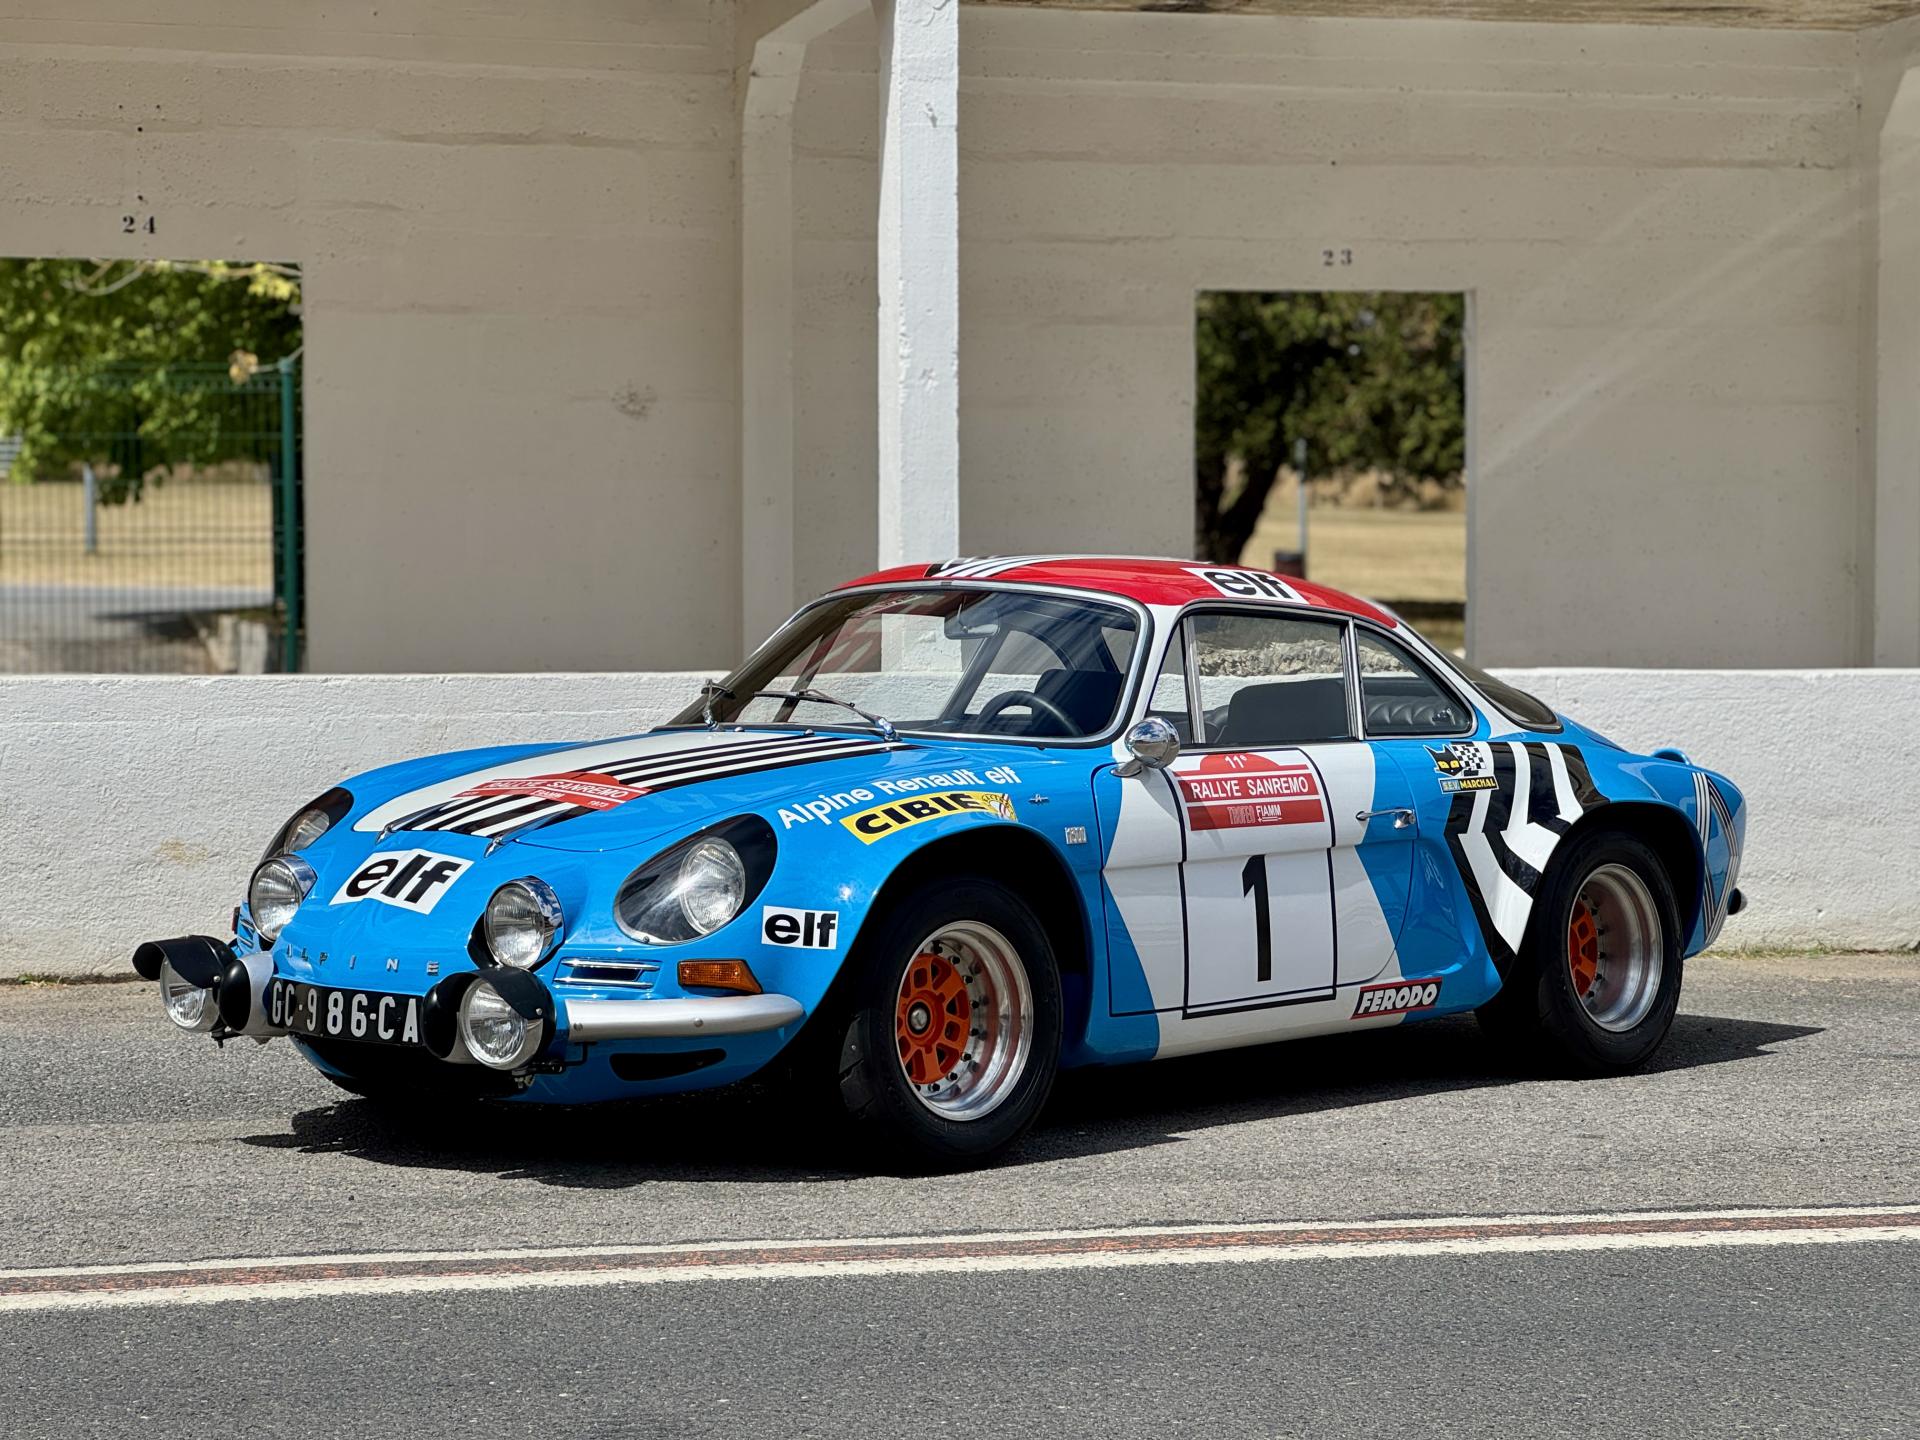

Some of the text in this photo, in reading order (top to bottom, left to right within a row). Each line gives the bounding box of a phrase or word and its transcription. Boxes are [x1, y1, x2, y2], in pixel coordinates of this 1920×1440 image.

[122, 214, 157, 234] 24
[1322, 248, 1352, 266] 23
[1203, 571, 1295, 600] elf
[546, 780, 629, 799] SANREMO
[1190, 776, 1309, 799] RALLYE SANREMO
[1460, 778, 1496, 789] MARCHAL
[777, 766, 1022, 830] Alpine Renault elf
[1255, 804, 1282, 818] FIAMM
[346, 853, 463, 904] elf
[764, 911, 837, 948] elf
[1242, 854, 1272, 982] 1
[1357, 983, 1438, 1015] FERODO
